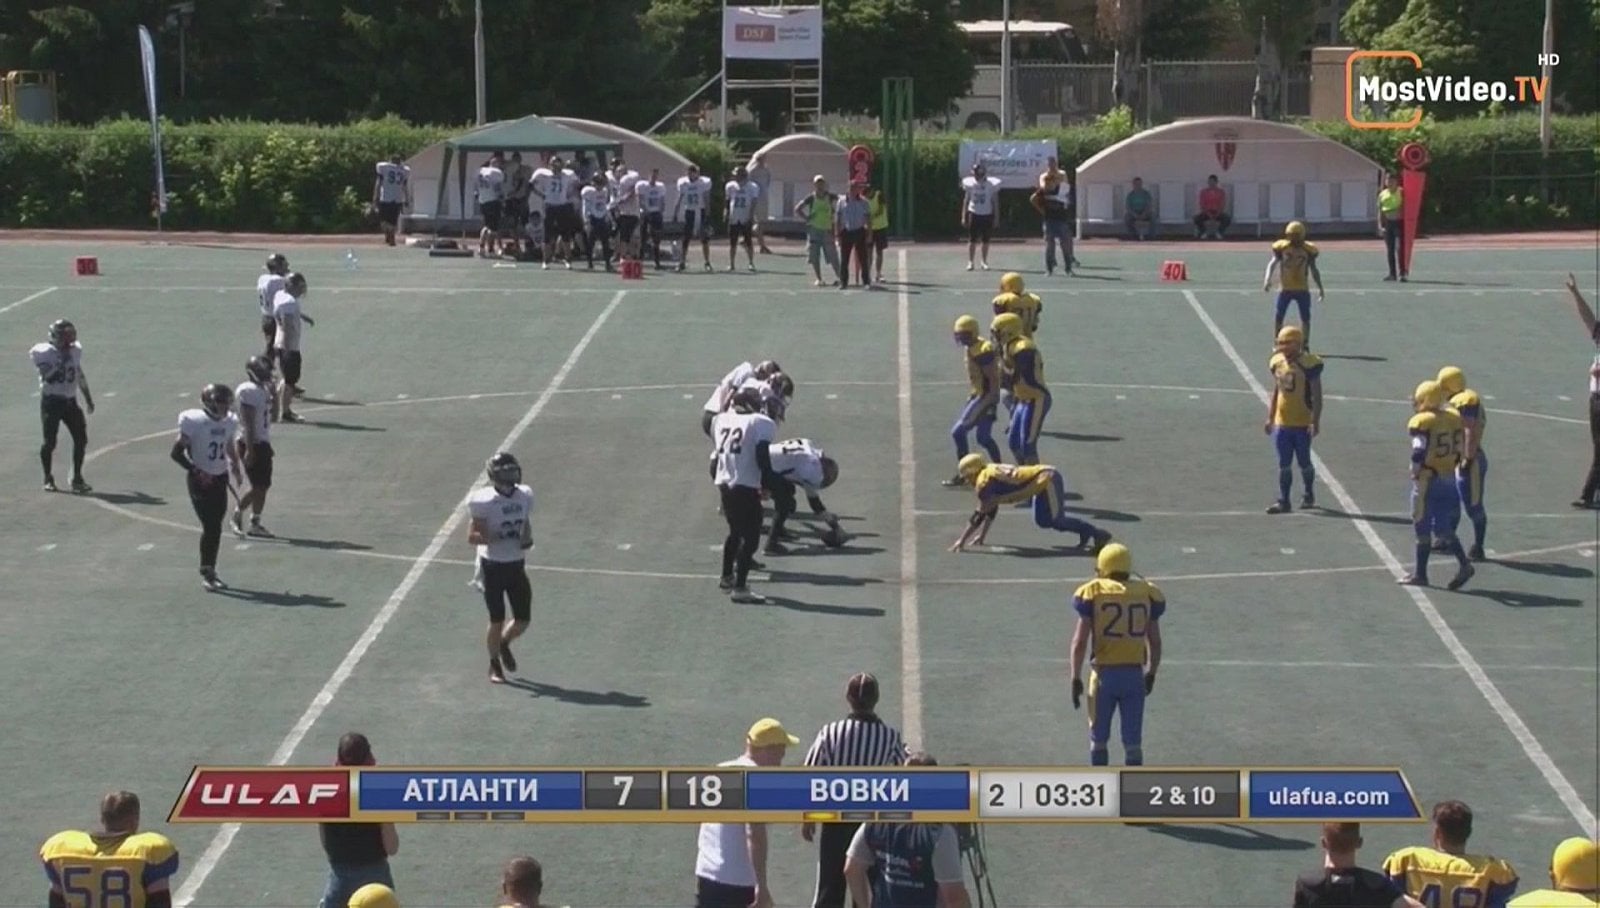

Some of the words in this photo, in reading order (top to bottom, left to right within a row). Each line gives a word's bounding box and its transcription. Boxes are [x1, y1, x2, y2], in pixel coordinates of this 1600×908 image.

[1164, 263, 1181, 280] 40
[719, 427, 742, 454] 72
[1102, 602, 1147, 638] 20
[64, 867, 131, 908] 58
